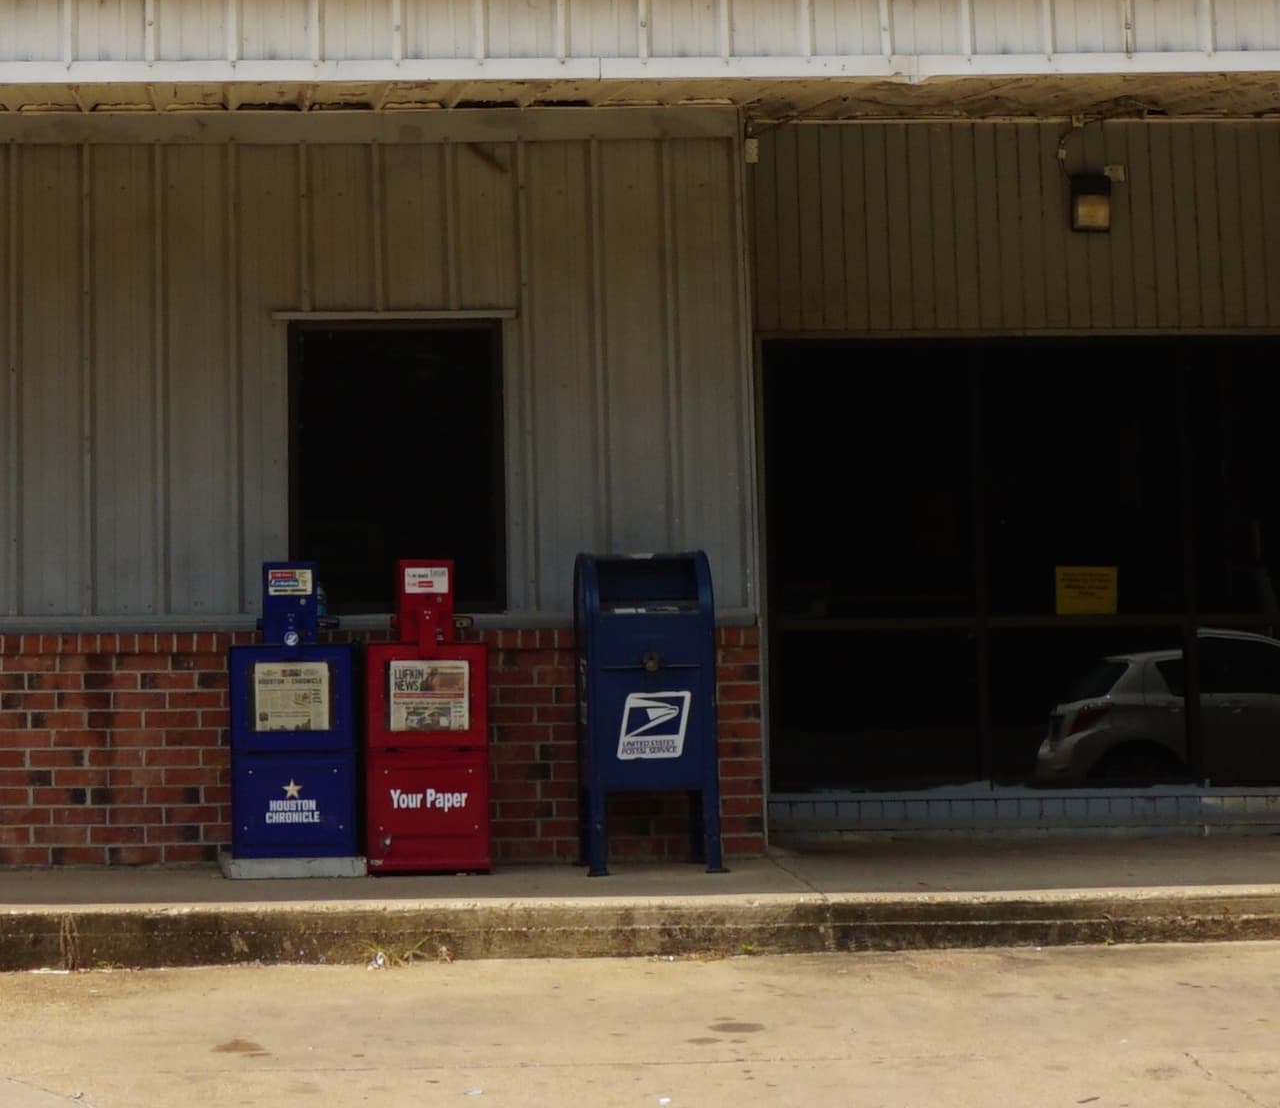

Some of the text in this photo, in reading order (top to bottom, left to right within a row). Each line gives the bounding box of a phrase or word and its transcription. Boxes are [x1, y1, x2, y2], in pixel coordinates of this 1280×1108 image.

[394, 680, 419, 692] NEWS
[622, 746, 678, 755] POSTAL SERVICE
[269, 799, 317, 811] HOUSTON
[390, 788, 468, 812] Your Paper
[265, 811, 321, 824] CHRONICLE
